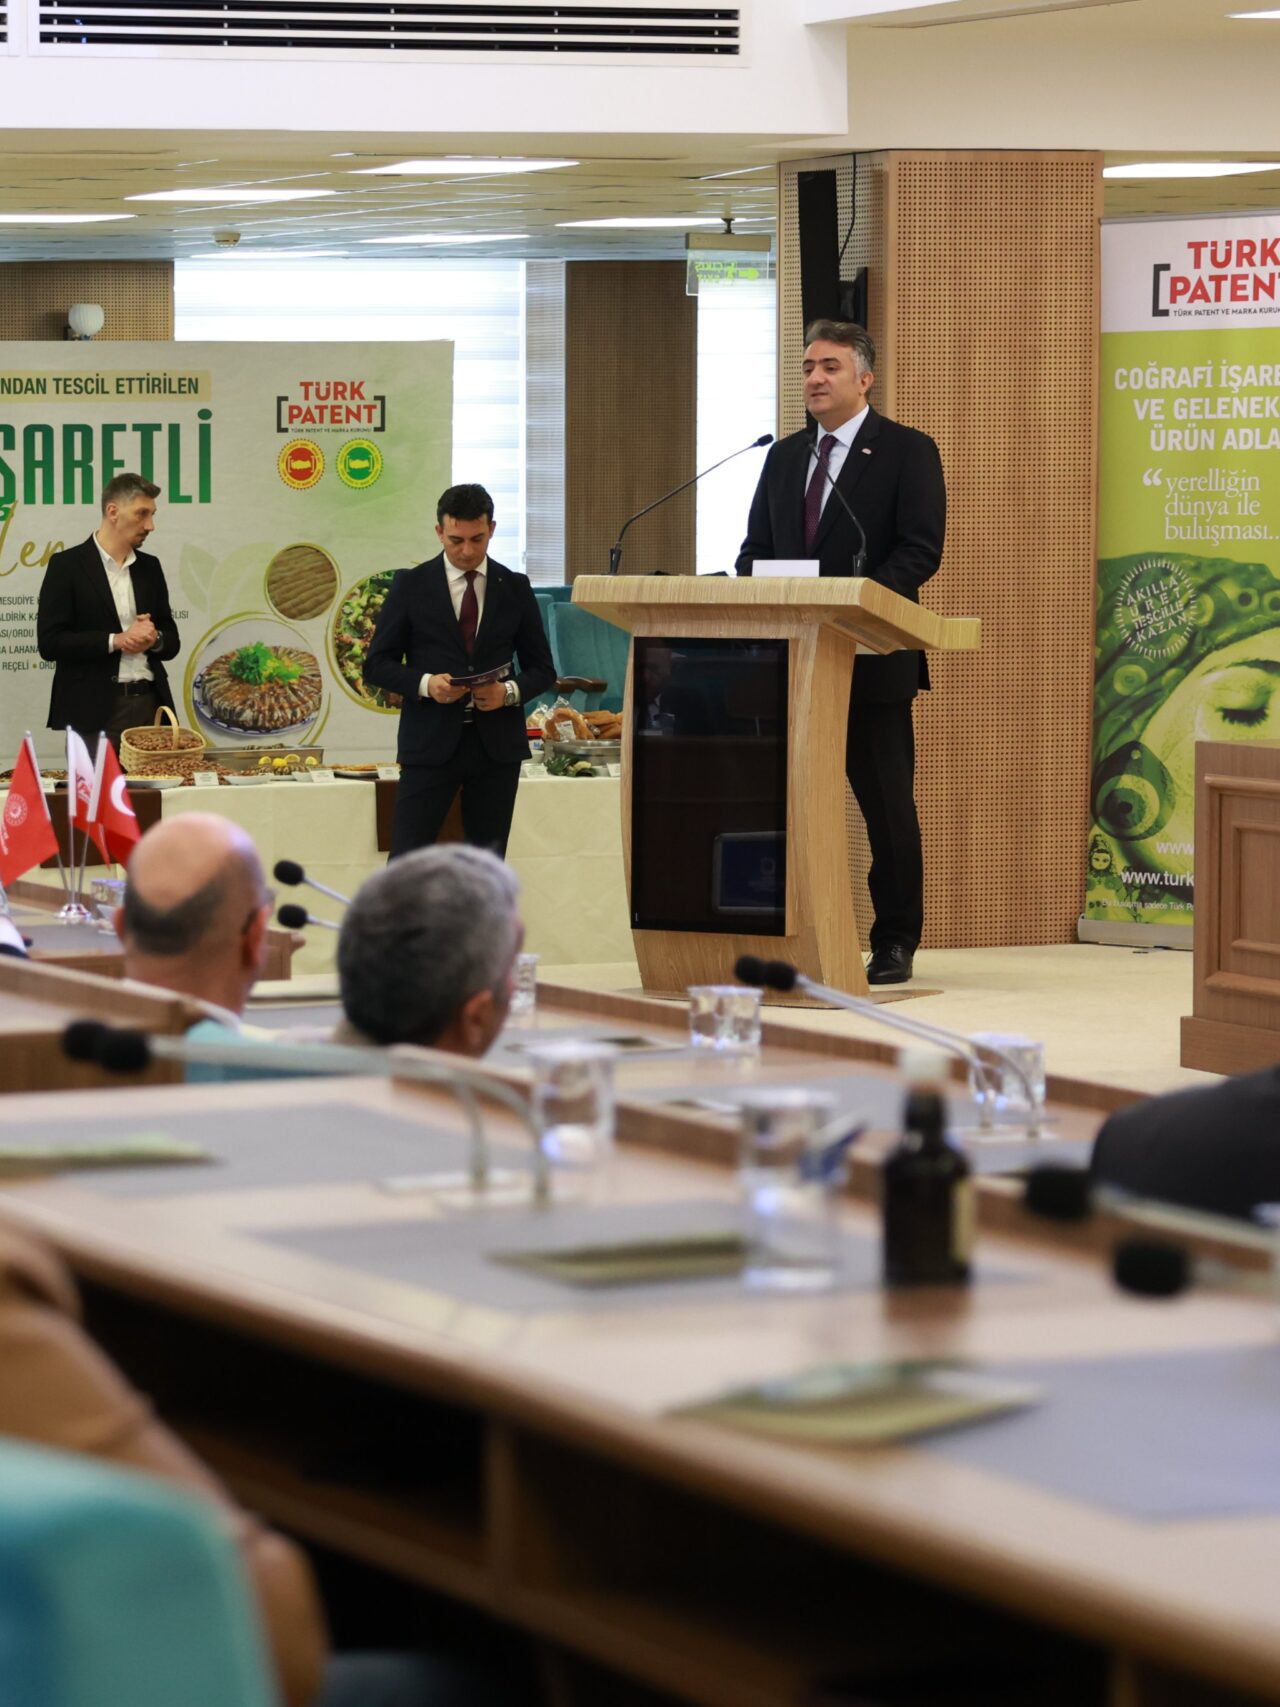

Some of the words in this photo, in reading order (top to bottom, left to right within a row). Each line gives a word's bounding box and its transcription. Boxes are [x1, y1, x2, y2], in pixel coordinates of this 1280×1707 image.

[1187, 237, 1280, 269] TÜRK
[1170, 272, 1280, 304] PATEN
[1173, 309, 1192, 317] TÜRK
[53, 373, 110, 394] TESCİL
[116, 373, 199, 394] ETTİRİLEN
[1114, 360, 1213, 389] COĞRAFİ
[299, 381, 366, 401] TÜRK
[288, 404, 377, 424] PATENT
[1133, 398, 1165, 420] VE
[1174, 396, 1280, 420] GELENEK
[1150, 423, 1215, 451] ÜRÜN
[1164, 493, 1229, 522] dünya
[1237, 492, 1261, 516] ile
[1127, 576, 1178, 606] AKILLA
[1136, 612, 1186, 642] KAZAN
[2, 660, 29, 672] REÇELİ
